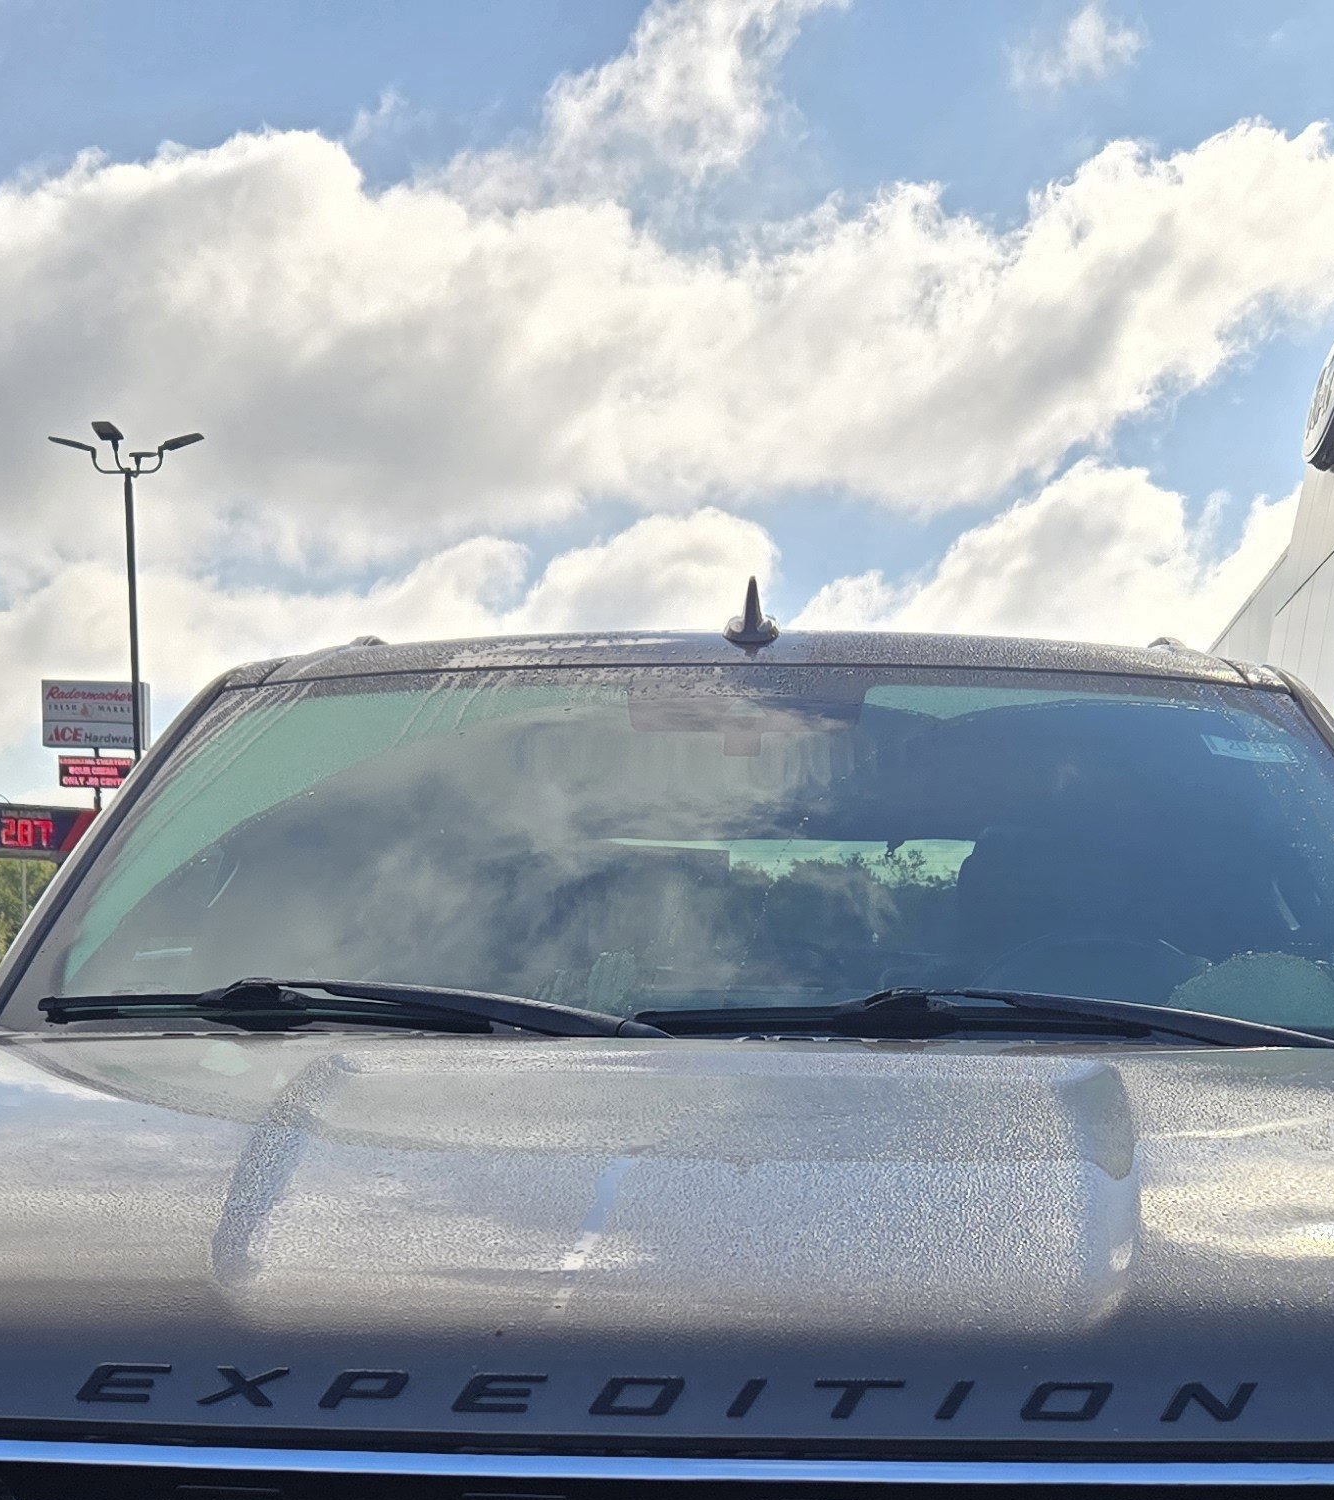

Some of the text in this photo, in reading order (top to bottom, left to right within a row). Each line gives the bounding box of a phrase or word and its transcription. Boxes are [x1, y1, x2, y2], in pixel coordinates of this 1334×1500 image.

[97, 705, 132, 714] MARKE
[48, 724, 134, 744] ACE Hardwar
[62, 776, 85, 785] ONLY
[75, 1362, 1259, 1422] EXPEDITION
